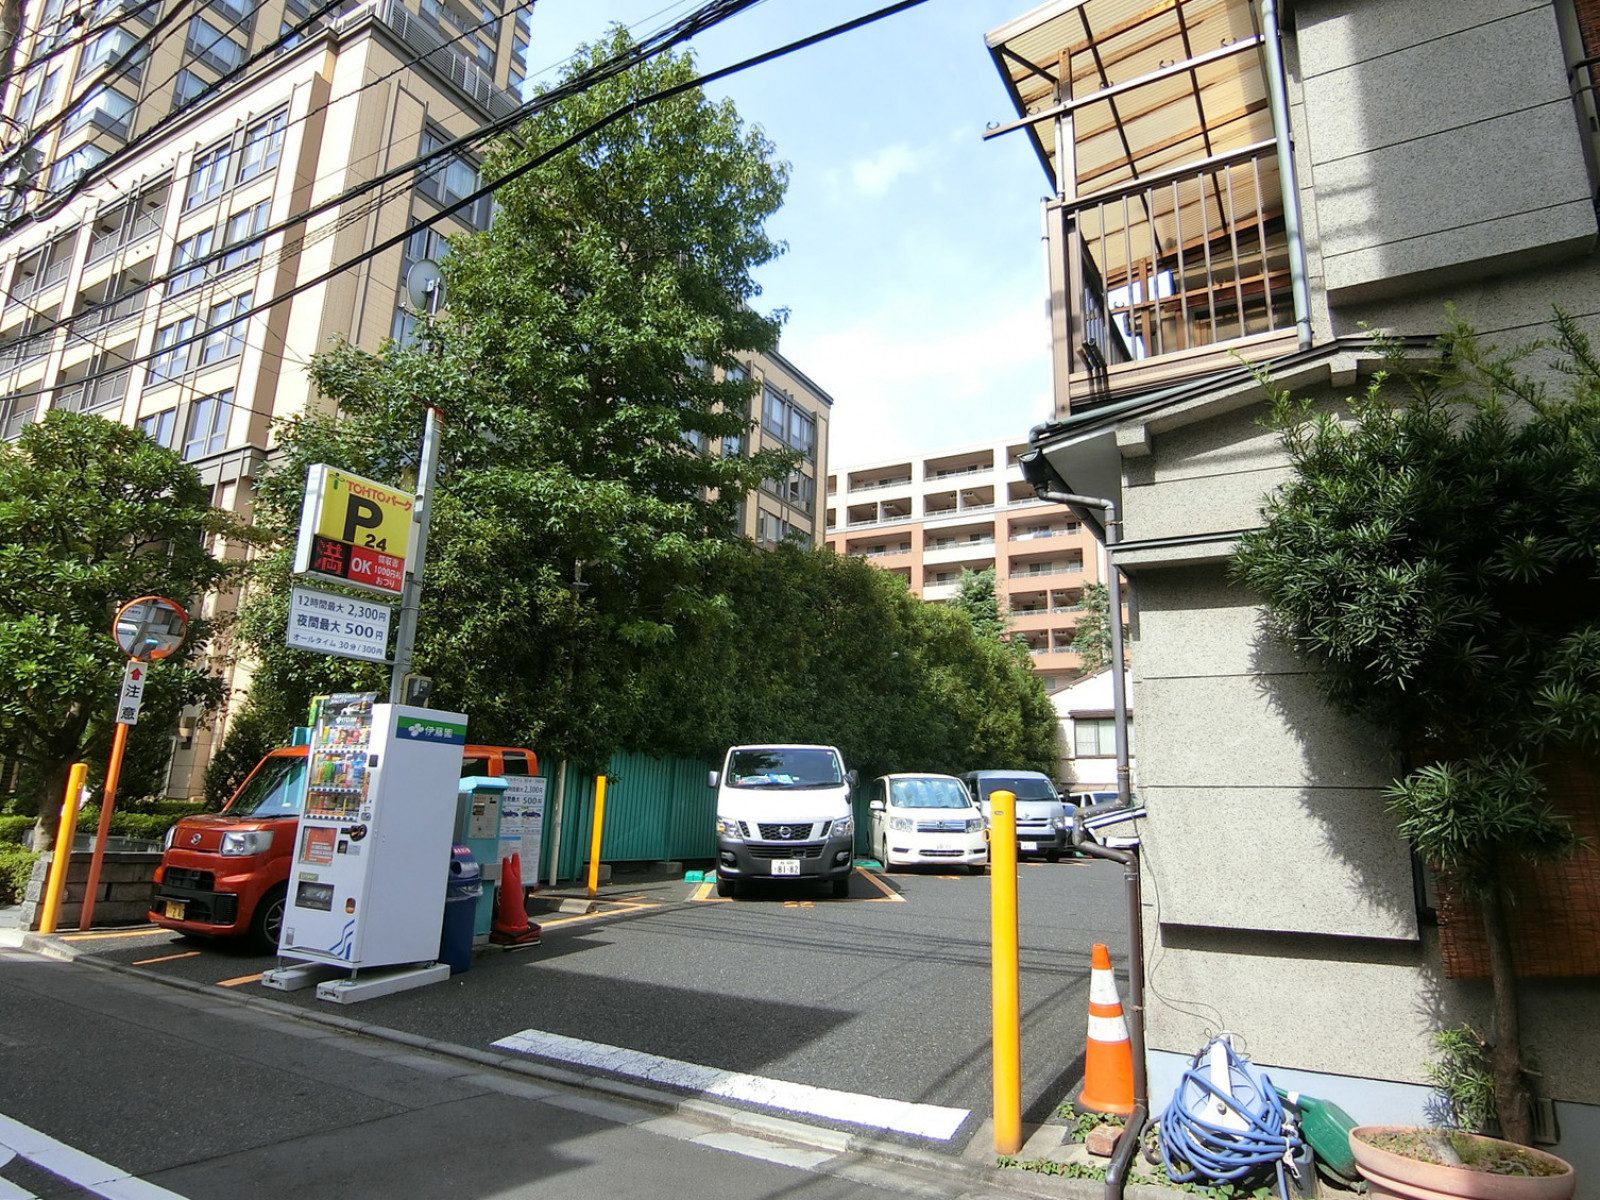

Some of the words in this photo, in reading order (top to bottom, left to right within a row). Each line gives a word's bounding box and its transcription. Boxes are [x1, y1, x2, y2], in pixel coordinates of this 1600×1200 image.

[345, 480, 412, 512] TOHTOパーク
[342, 493, 384, 544] P
[364, 533, 388, 553] 24
[314, 539, 344, 576] 満
[351, 557, 373, 575] OK
[375, 576, 396, 589] おつり
[298, 595, 345, 614] 12時間最大
[347, 603, 387, 623] 2,300円
[296, 613, 341, 634] 夜間最大
[293, 633, 337, 648] オールタイム
[362, 645, 383, 656] 300円
[120, 684, 141, 721] 注意
[425, 725, 453, 739] 伊藤園
